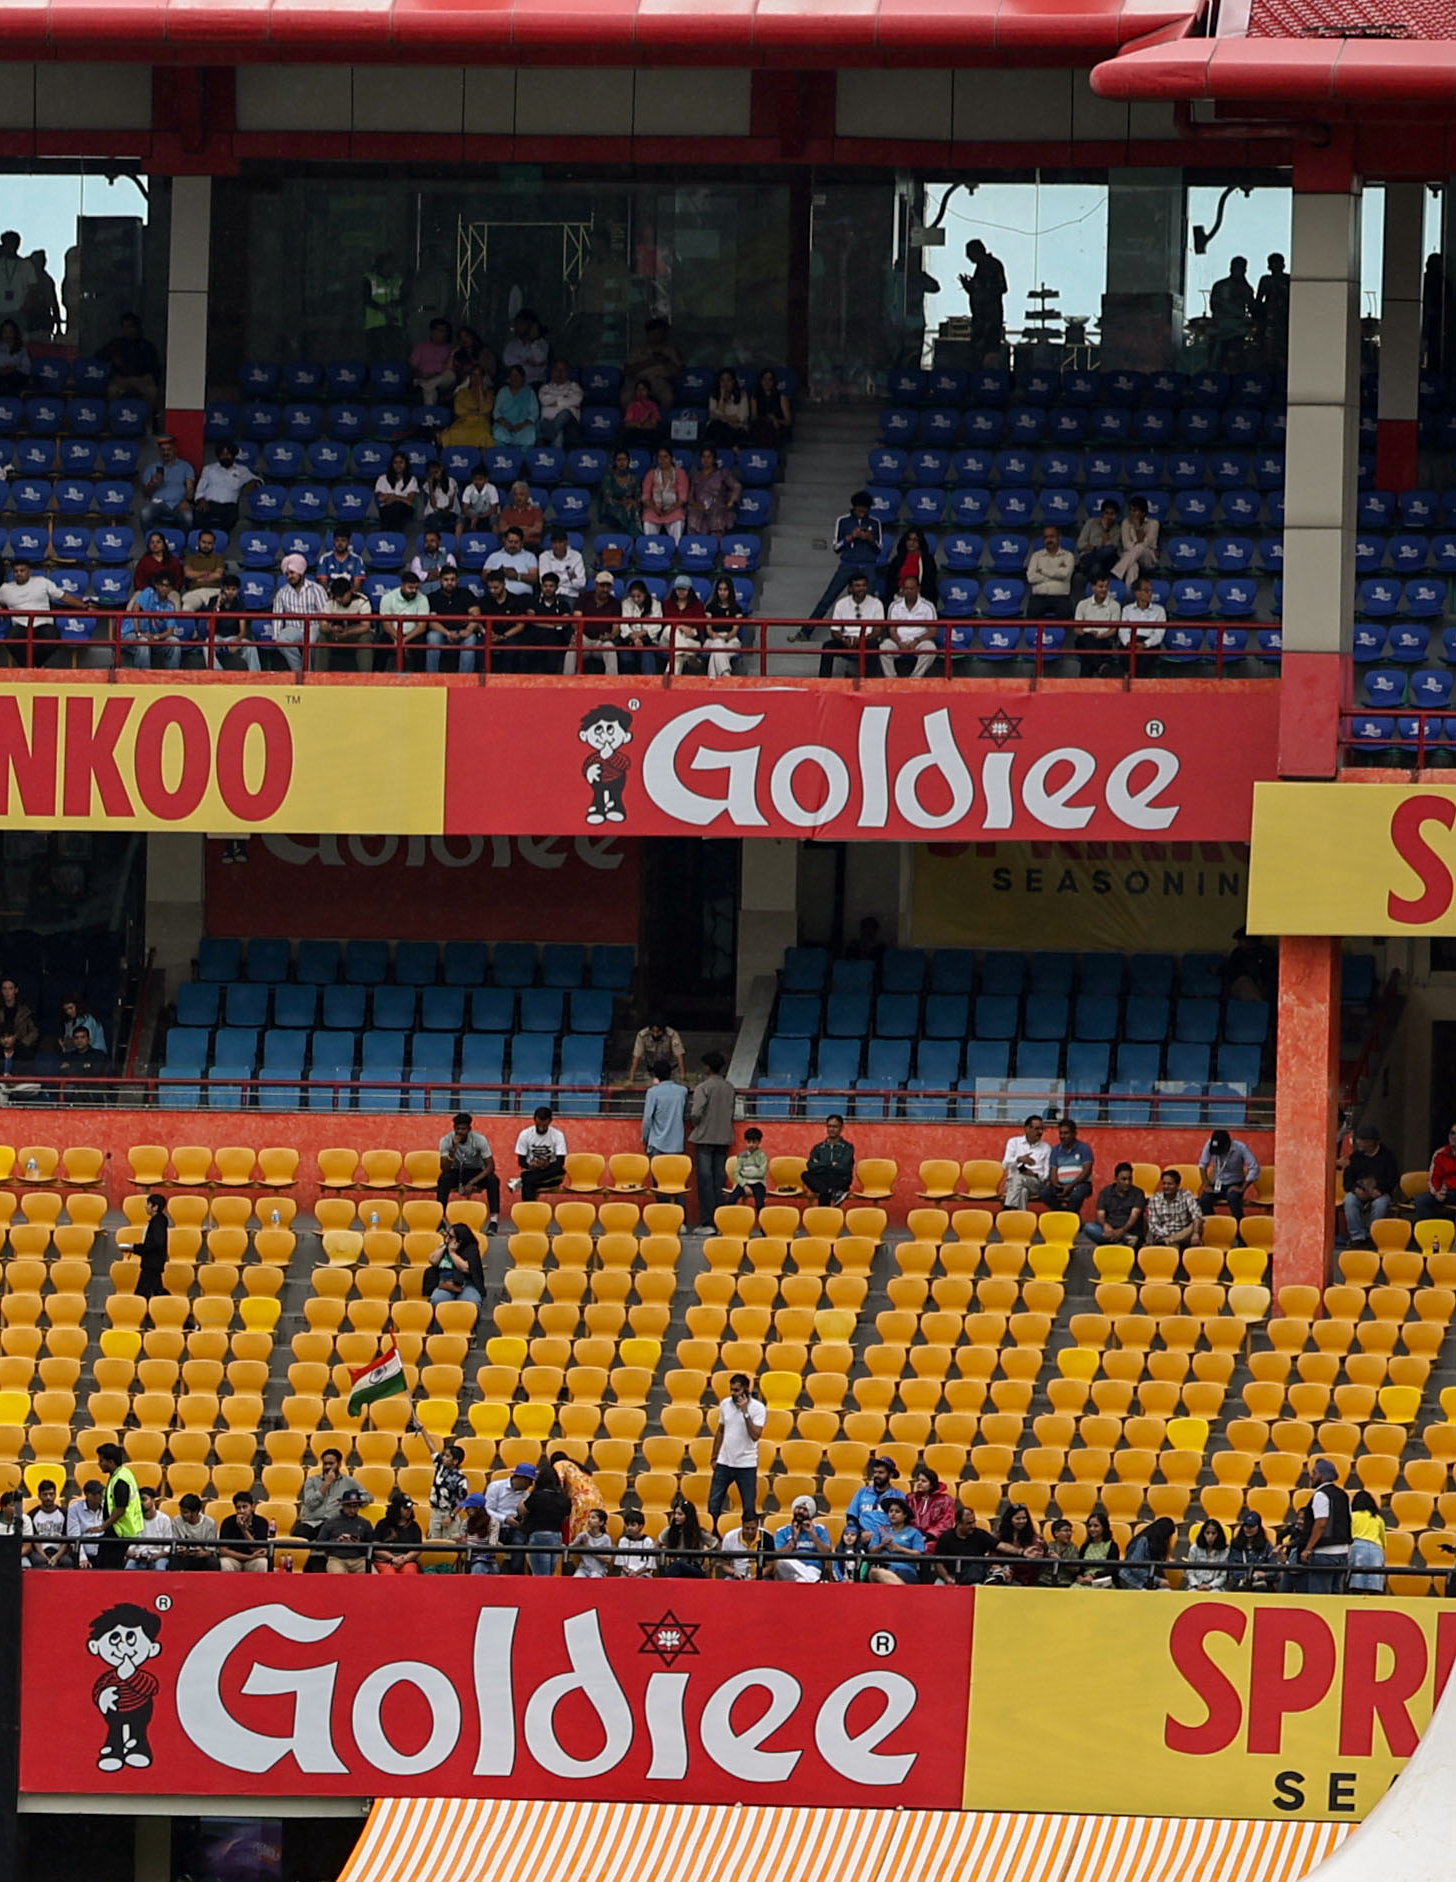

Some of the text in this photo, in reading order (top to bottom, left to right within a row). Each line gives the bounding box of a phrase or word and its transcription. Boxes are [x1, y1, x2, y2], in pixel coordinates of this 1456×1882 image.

[642, 703, 1180, 829] Goldiee
[176, 1603, 917, 1785] Goldiee
[1273, 1771, 1398, 1811] SE
